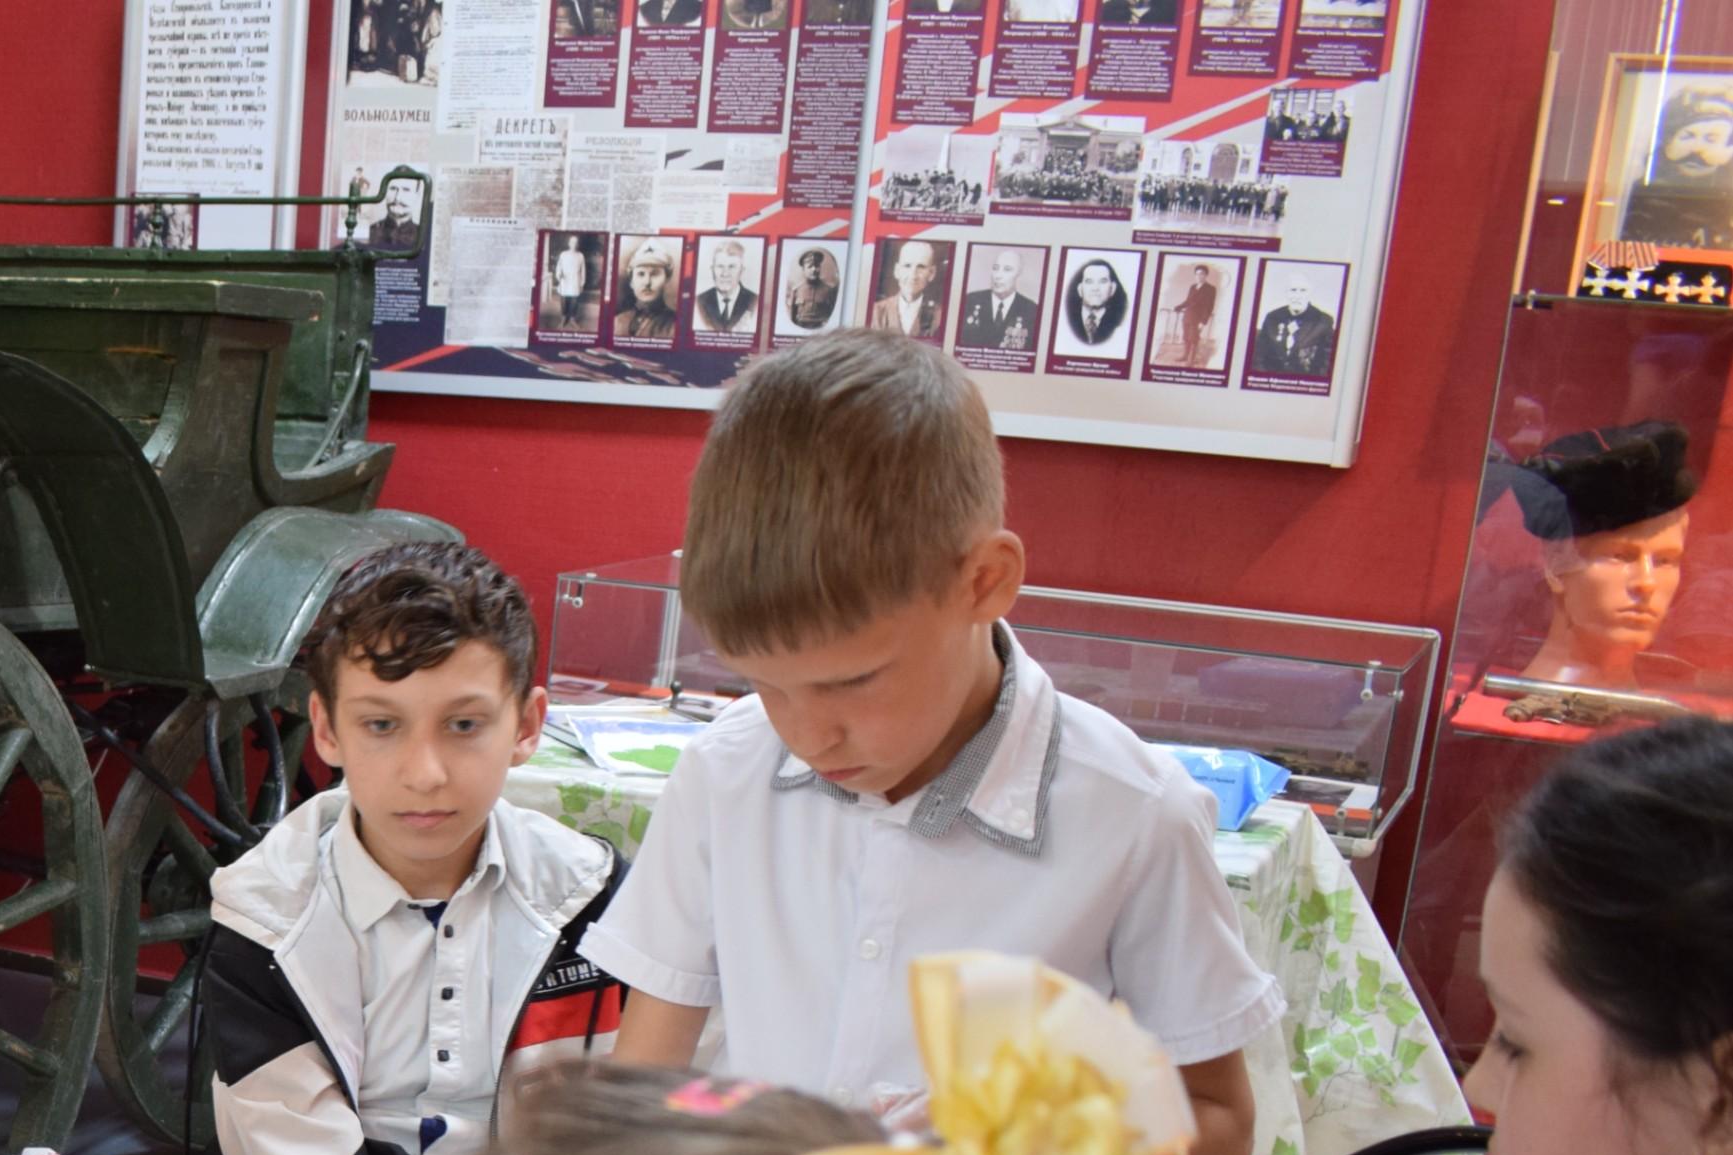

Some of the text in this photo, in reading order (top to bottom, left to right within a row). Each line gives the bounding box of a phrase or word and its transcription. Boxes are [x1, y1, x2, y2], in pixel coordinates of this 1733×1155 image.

[343, 107, 431, 123] ВОЛЬНОДУМЕЦ
[494, 118, 556, 135] ДЕКРЕТЪ
[536, 962, 601, 990] RTUNE
